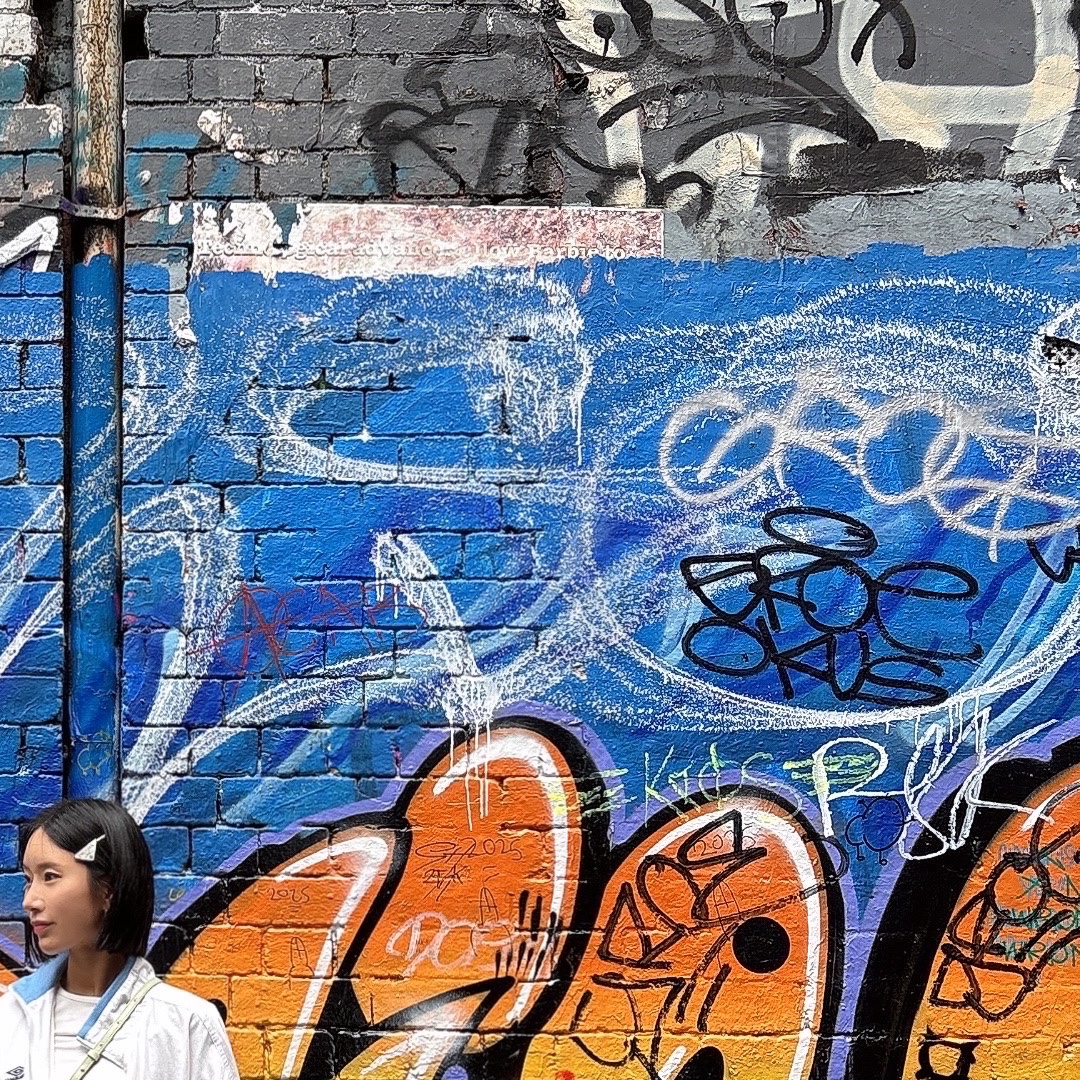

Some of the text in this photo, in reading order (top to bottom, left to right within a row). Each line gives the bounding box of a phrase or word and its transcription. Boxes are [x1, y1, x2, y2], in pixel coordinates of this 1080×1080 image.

[604, 246, 626, 259] to
[461, 837, 522, 860] 2025
[269, 887, 310, 904] 2025
